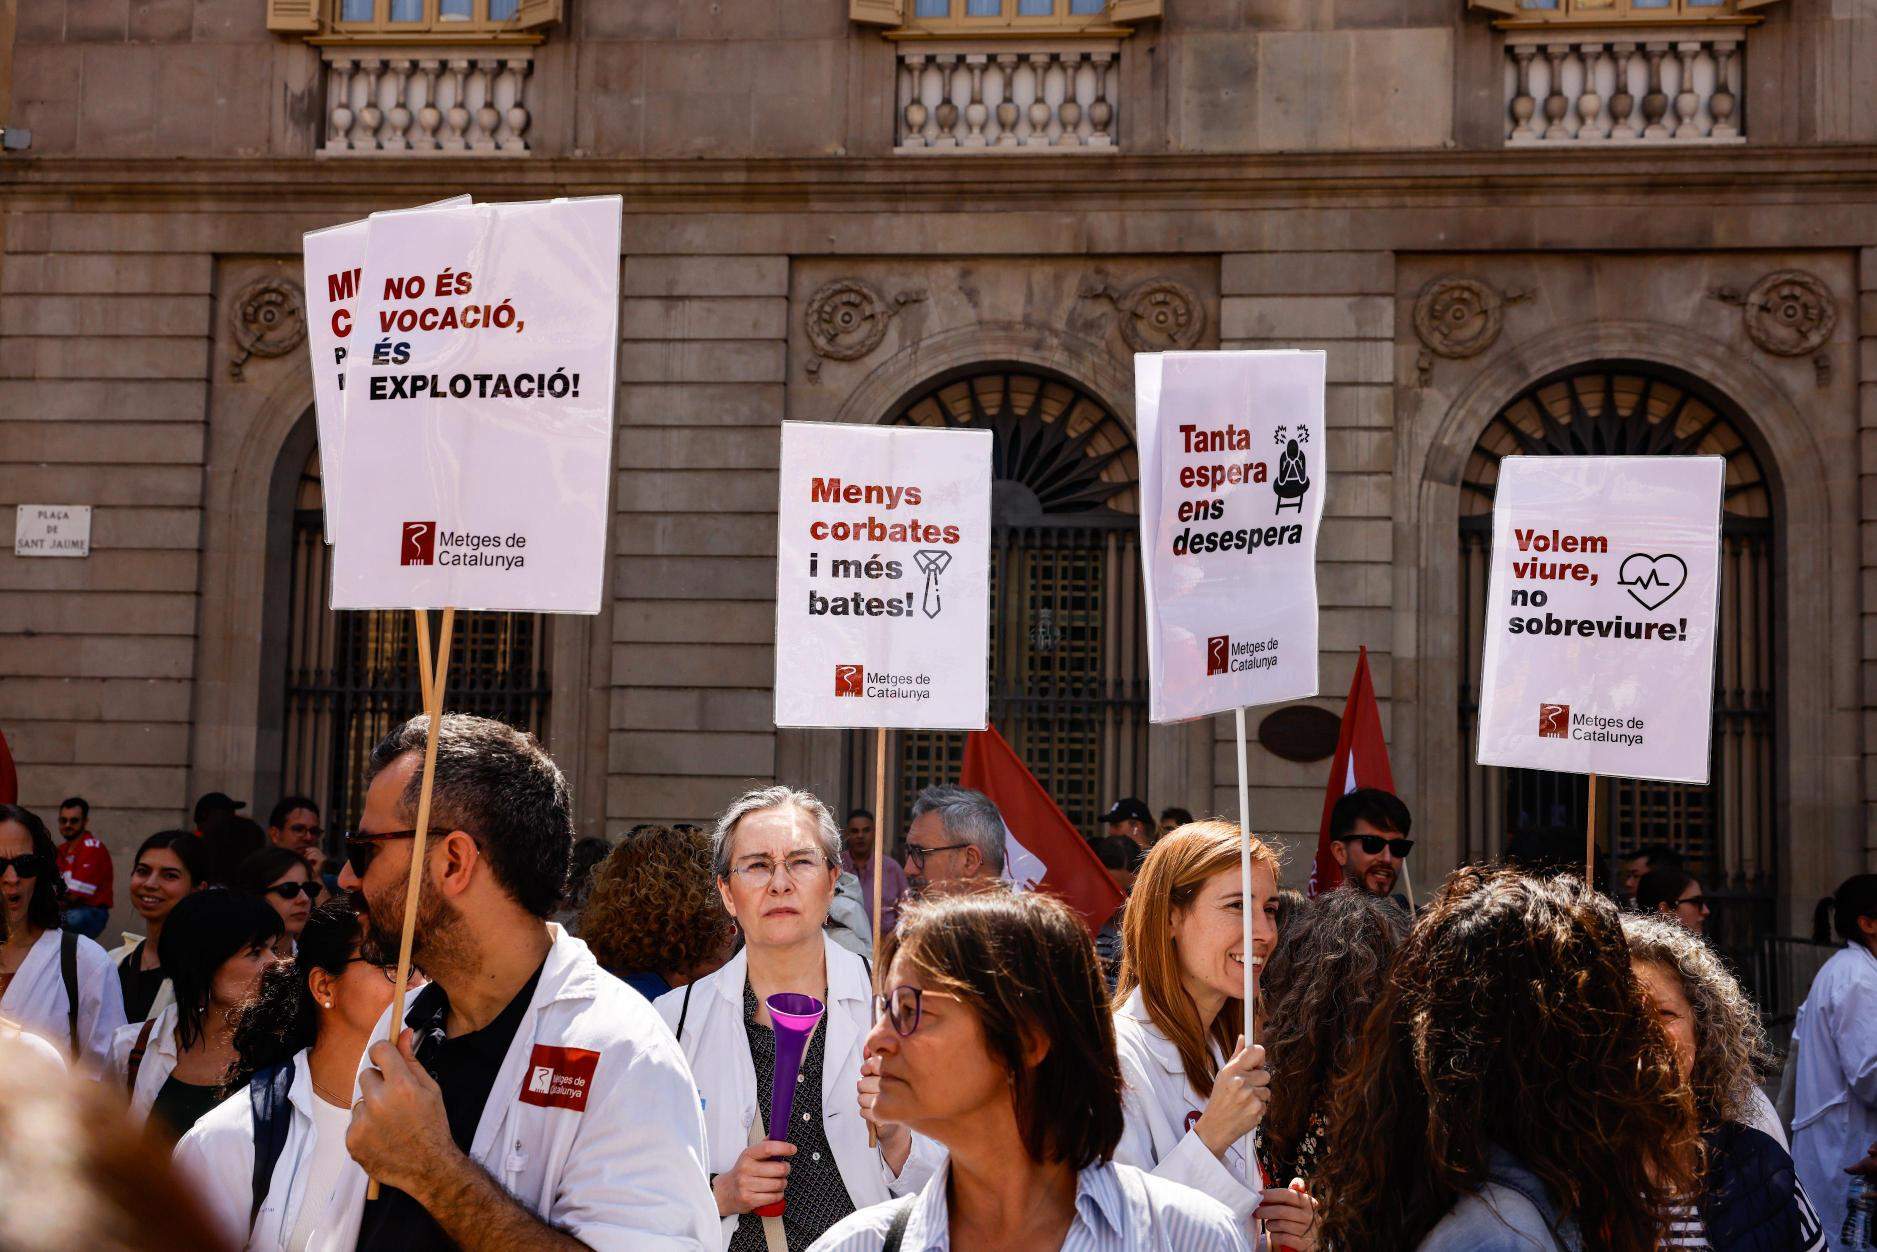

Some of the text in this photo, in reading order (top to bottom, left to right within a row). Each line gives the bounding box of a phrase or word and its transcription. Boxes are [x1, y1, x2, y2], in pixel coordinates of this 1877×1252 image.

[384, 268, 472, 300] NO ÉS
[380, 299, 524, 333] VOCACIÓ,
[372, 338, 410, 365] ÉS
[370, 367, 579, 400] EXPLOTACIÓ!
[1180, 425, 1250, 453] Tanta
[1180, 462, 1267, 492] espera
[812, 478, 921, 509] Menys
[38, 510, 69, 520] PLAÇA
[1178, 499, 1224, 522] ens
[46, 525, 58, 534] DE
[440, 532, 525, 549] Metges de
[810, 517, 960, 544] corbates
[1173, 524, 1302, 556] desespera
[1515, 529, 1607, 553] Volem
[18, 539, 86, 550] SANT JAUME
[439, 548, 524, 570] Catalunya
[810, 553, 902, 579] i més
[1513, 557, 1598, 586] viure,
[809, 590, 913, 616] bates!
[1511, 590, 1547, 607] no
[1509, 613, 1687, 641] sobreviure!
[1232, 638, 1278, 656] Metges de
[1231, 653, 1277, 672] Catalunya
[868, 673, 930, 687] Metges de
[867, 687, 929, 701] Catalunya
[1573, 714, 1643, 730] Metges de
[1573, 728, 1643, 746] Catalunya
[573, 1076, 586, 1086] de
